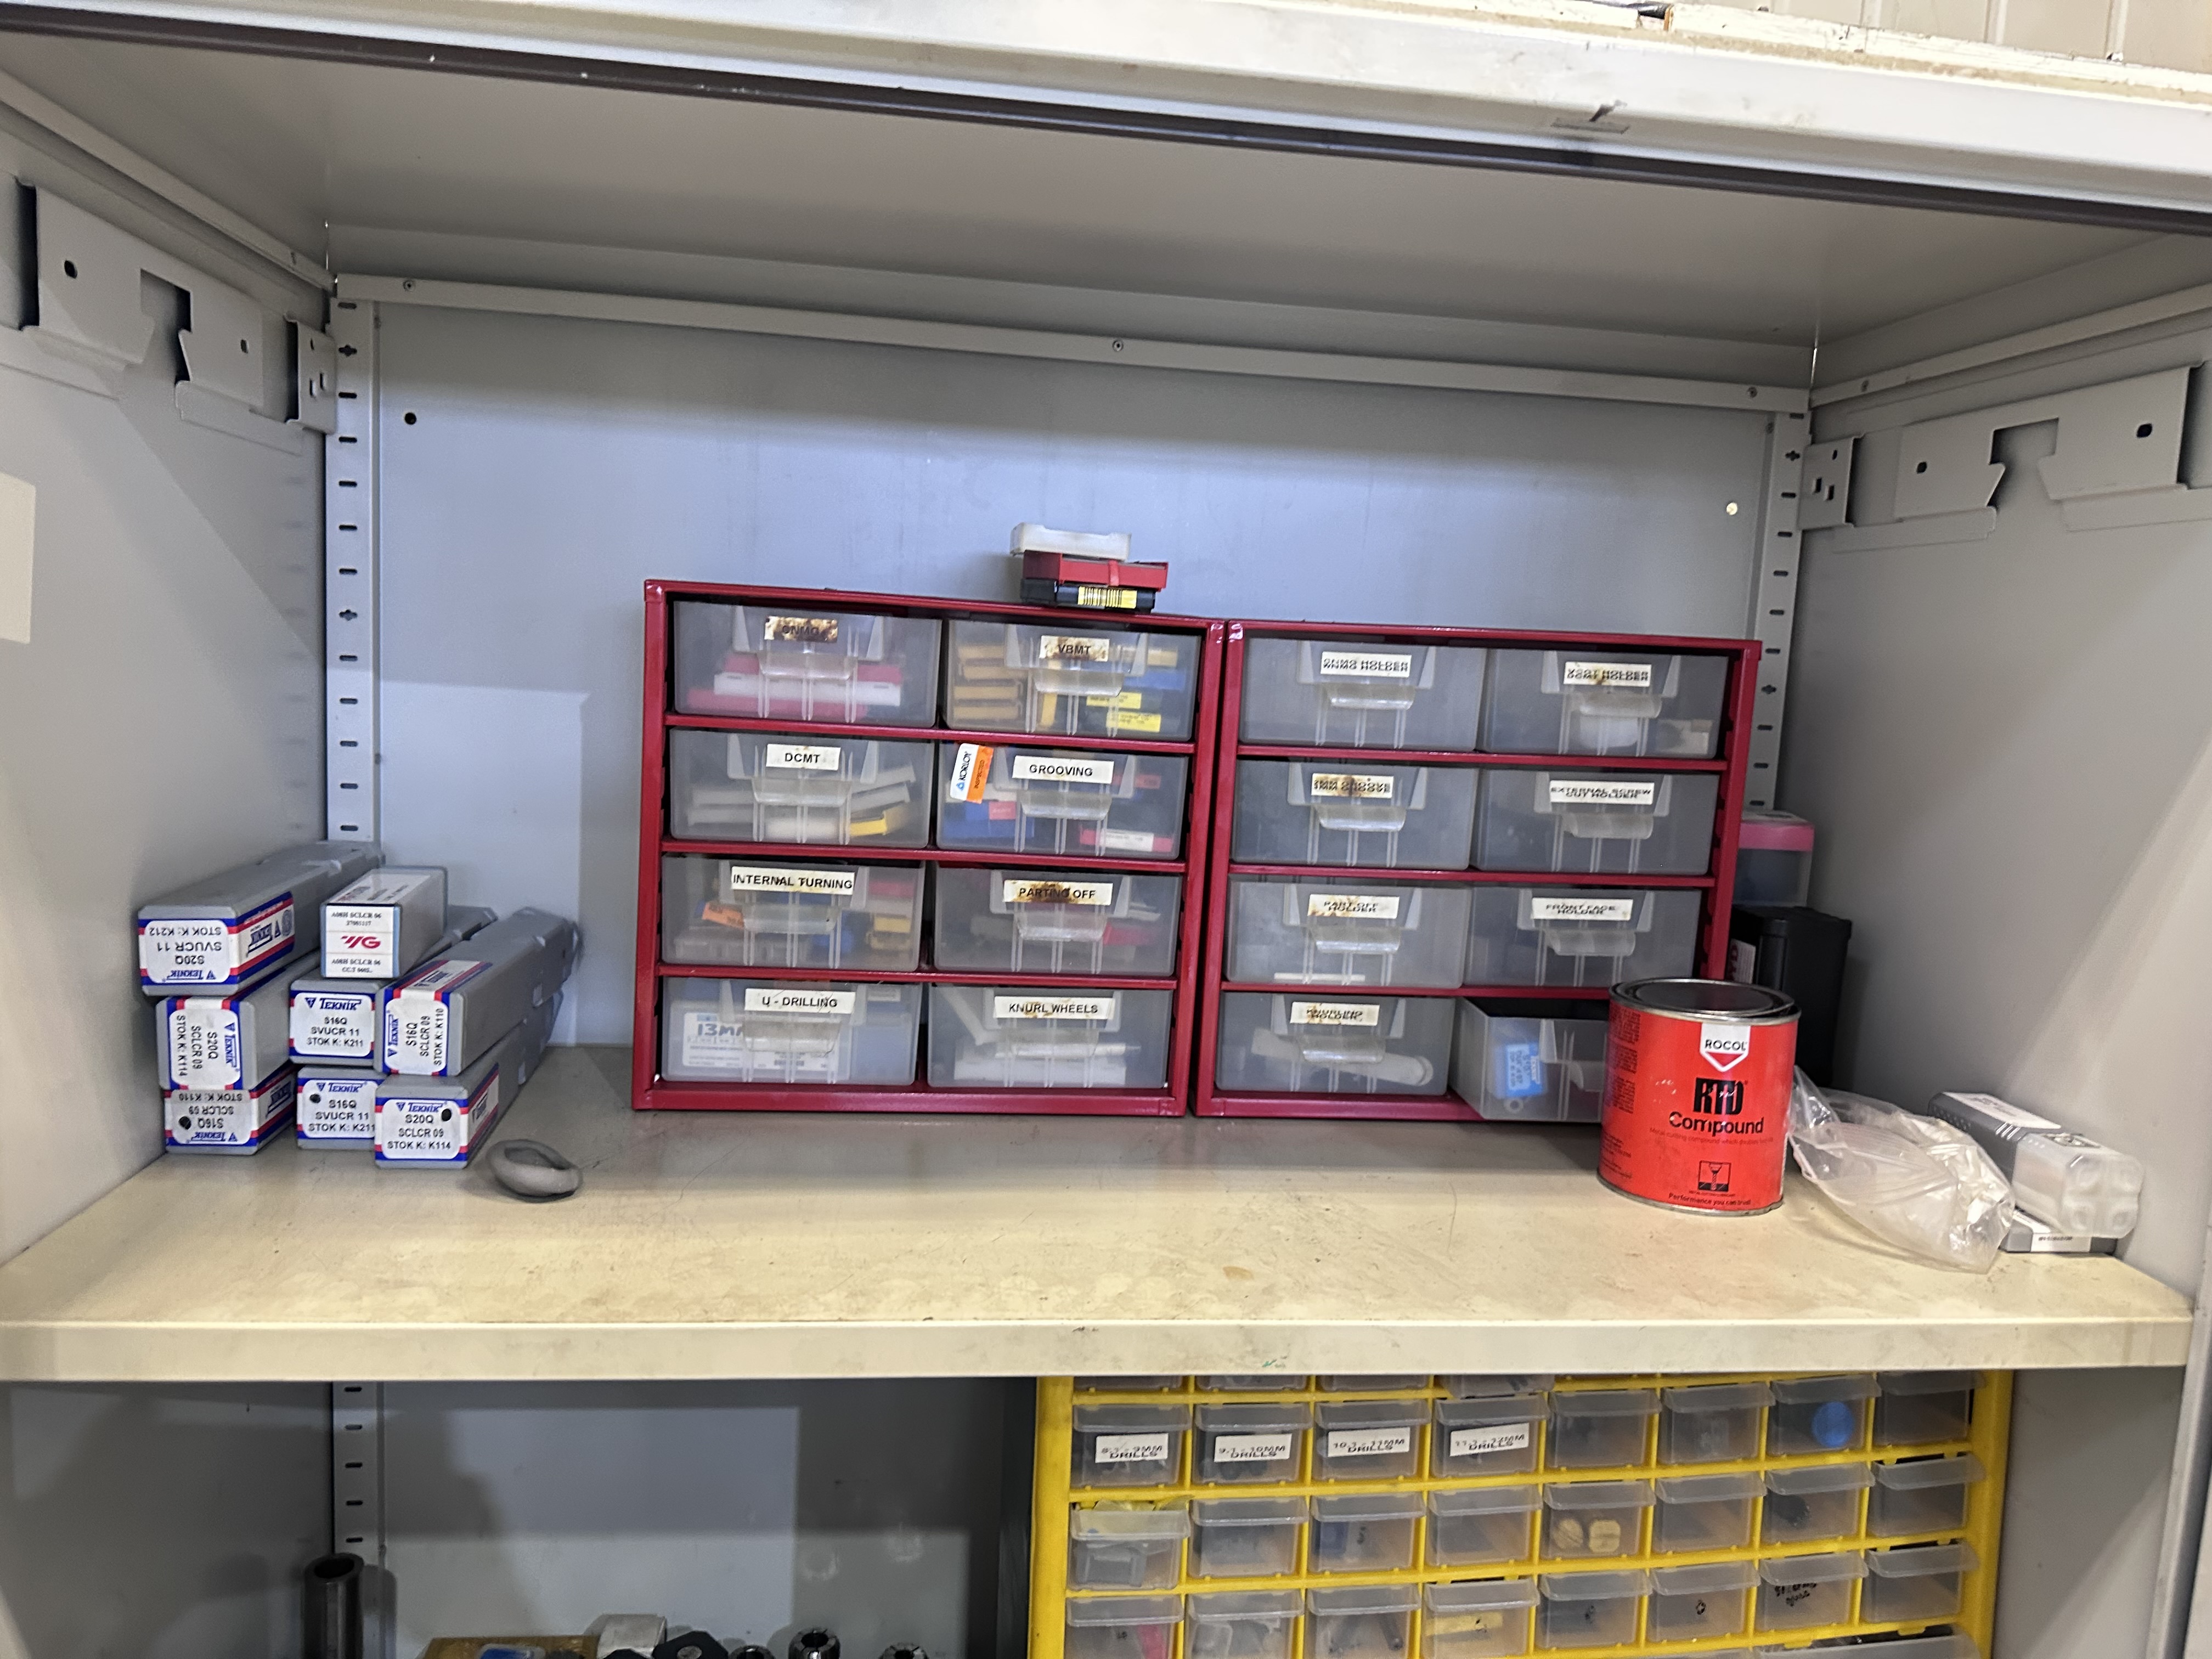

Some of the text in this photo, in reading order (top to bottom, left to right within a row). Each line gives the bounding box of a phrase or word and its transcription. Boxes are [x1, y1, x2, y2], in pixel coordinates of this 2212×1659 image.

[1058, 644, 1092, 654] VBMT
[785, 753, 820, 764] DCMT
[1029, 764, 1093, 777] GROOVING
[733, 873, 853, 889] INTERNAL TURNING
[1019, 887, 1096, 899] PARTING OFF
[149, 927, 174, 936] K212
[194, 927, 221, 936] STOK
[157, 941, 222, 951] SVUCR 11
[174, 955, 205, 965] S20Q
[762, 996, 770, 1007] U
[782, 997, 838, 1008] DRILLING
[1009, 1002, 1098, 1014] KNURL WHEELS
[324, 1017, 347, 1025] S16Q
[435, 1008, 443, 1027] K110
[176, 1015, 186, 1041] STOK
[311, 1027, 347, 1036] SVUCR
[405, 1022, 417, 1046] S16Q
[420, 1015, 430, 1057] SCLCR 09
[191, 1025, 202, 1069] SCLCR 09
[207, 1032, 218, 1059] S20Q
[306, 1037, 330, 1046] STOK
[343, 1038, 364, 1047] K211
[1705, 1039, 1747, 1052] ROCOL
[433, 1041, 442, 1066] STOK
[179, 1056, 187, 1076] K114
[216, 1093, 242, 1101] STOK
[1693, 1077, 1745, 1115] RTD
[329, 1100, 357, 1109] S16Q
[201, 1106, 234, 1115] SCLCR
[315, 1111, 369, 1120] SVUCR 11
[197, 1118, 224, 1128] S16Q
[405, 1114, 433, 1124] S20Q
[1669, 1111, 1764, 1136] Compound
[308, 1124, 337, 1132] STOK
[398, 1128, 444, 1137] SCLCR 09
[387, 1141, 414, 1149] STOK
[428, 1142, 451, 1150] K114
[1669, 1192, 1712, 1205] Performance
